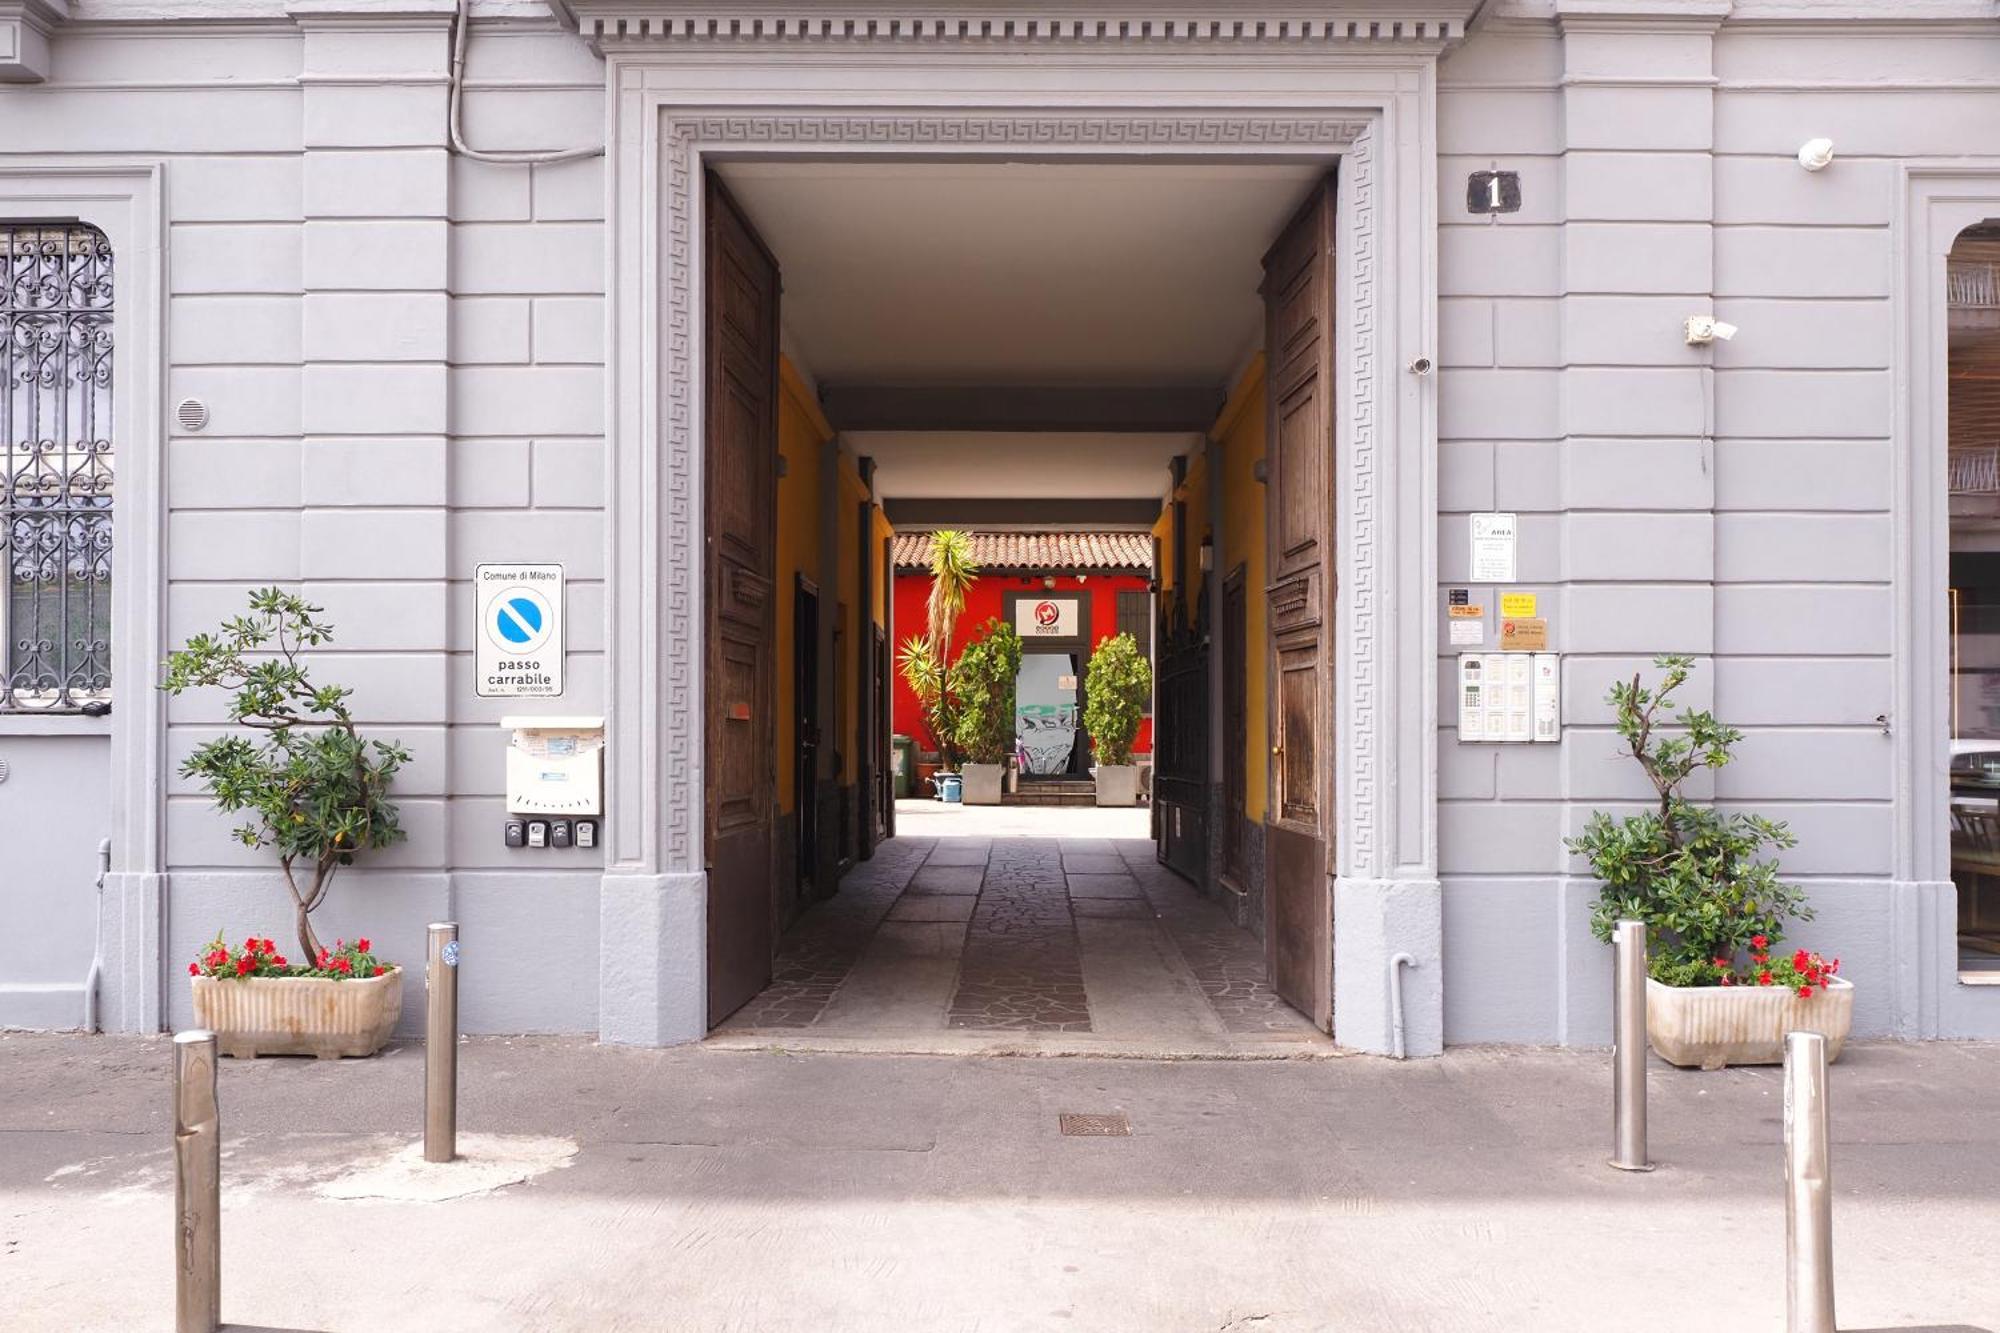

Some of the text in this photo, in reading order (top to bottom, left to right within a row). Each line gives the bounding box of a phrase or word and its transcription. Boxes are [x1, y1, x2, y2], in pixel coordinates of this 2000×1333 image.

[1487, 176, 1501, 208] 1
[483, 571, 557, 581] Comune di Milano
[498, 660, 541, 672] passo
[487, 672, 552, 685] carrabile
